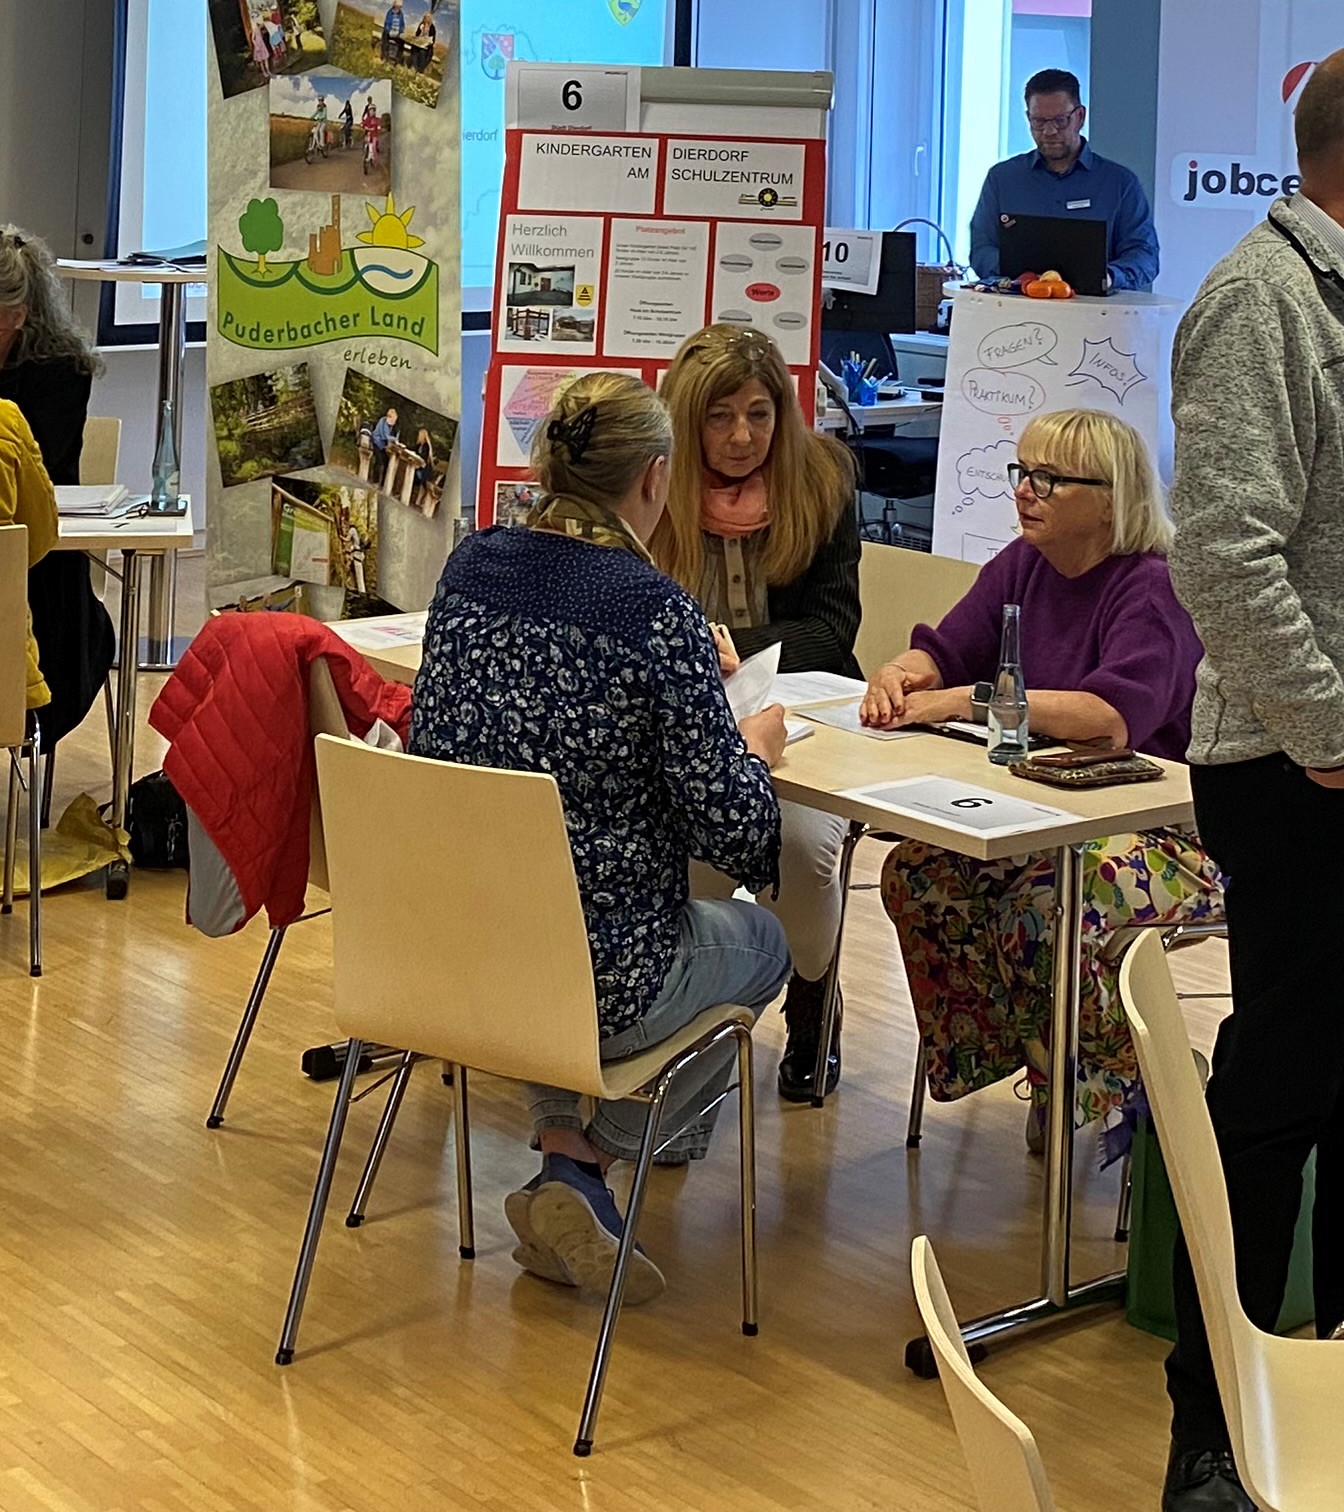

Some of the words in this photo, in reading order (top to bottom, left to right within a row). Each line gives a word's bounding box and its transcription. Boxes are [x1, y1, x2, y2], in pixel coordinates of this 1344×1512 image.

[562, 79, 583, 111] 6
[462, 128, 498, 142] ierdorf
[536, 142, 652, 159] KINDERGARTEN
[672, 147, 749, 162] DIERDORF
[626, 167, 650, 180] AM
[671, 168, 794, 186] SCHULZENTRUM
[1183, 159, 1303, 202] jobce
[512, 223, 567, 238] Herzlich
[511, 243, 595, 259] Willkommen
[822, 241, 849, 263] 10
[222, 311, 361, 343] Puderbacher
[370, 305, 426, 337] Land
[983, 327, 1043, 361] FRAGEN?
[1088, 352, 1139, 386] INFOS!
[968, 379, 1036, 410] PRAKTIKUM?
[950, 797, 994, 809] 6
